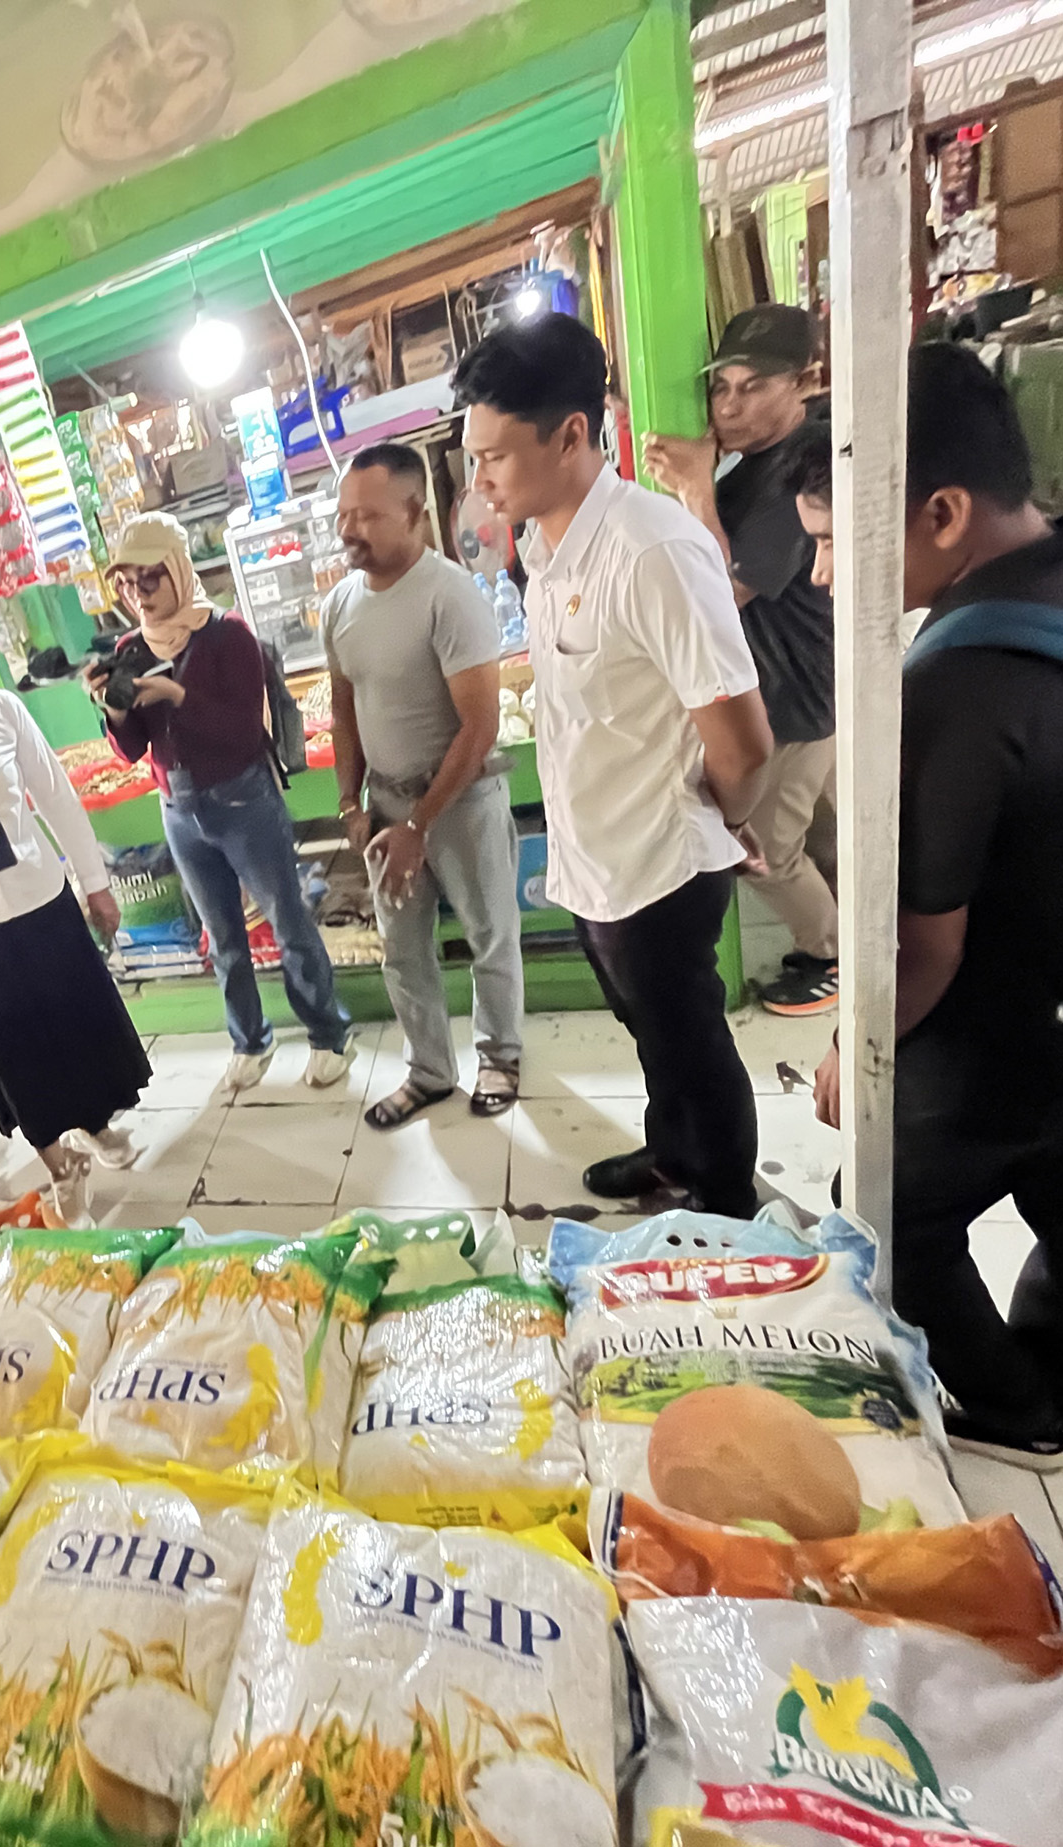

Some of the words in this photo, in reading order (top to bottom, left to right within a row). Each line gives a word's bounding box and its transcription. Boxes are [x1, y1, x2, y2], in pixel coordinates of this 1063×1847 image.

[110, 869, 153, 889] Bumi
[614, 1261, 799, 1295] SUPER
[599, 1325, 704, 1361] BUAH
[722, 1323, 880, 1369] MELON
[99, 1367, 226, 1406] SPHP
[45, 1529, 217, 1592] SPHP
[354, 1568, 563, 1662] SPHP
